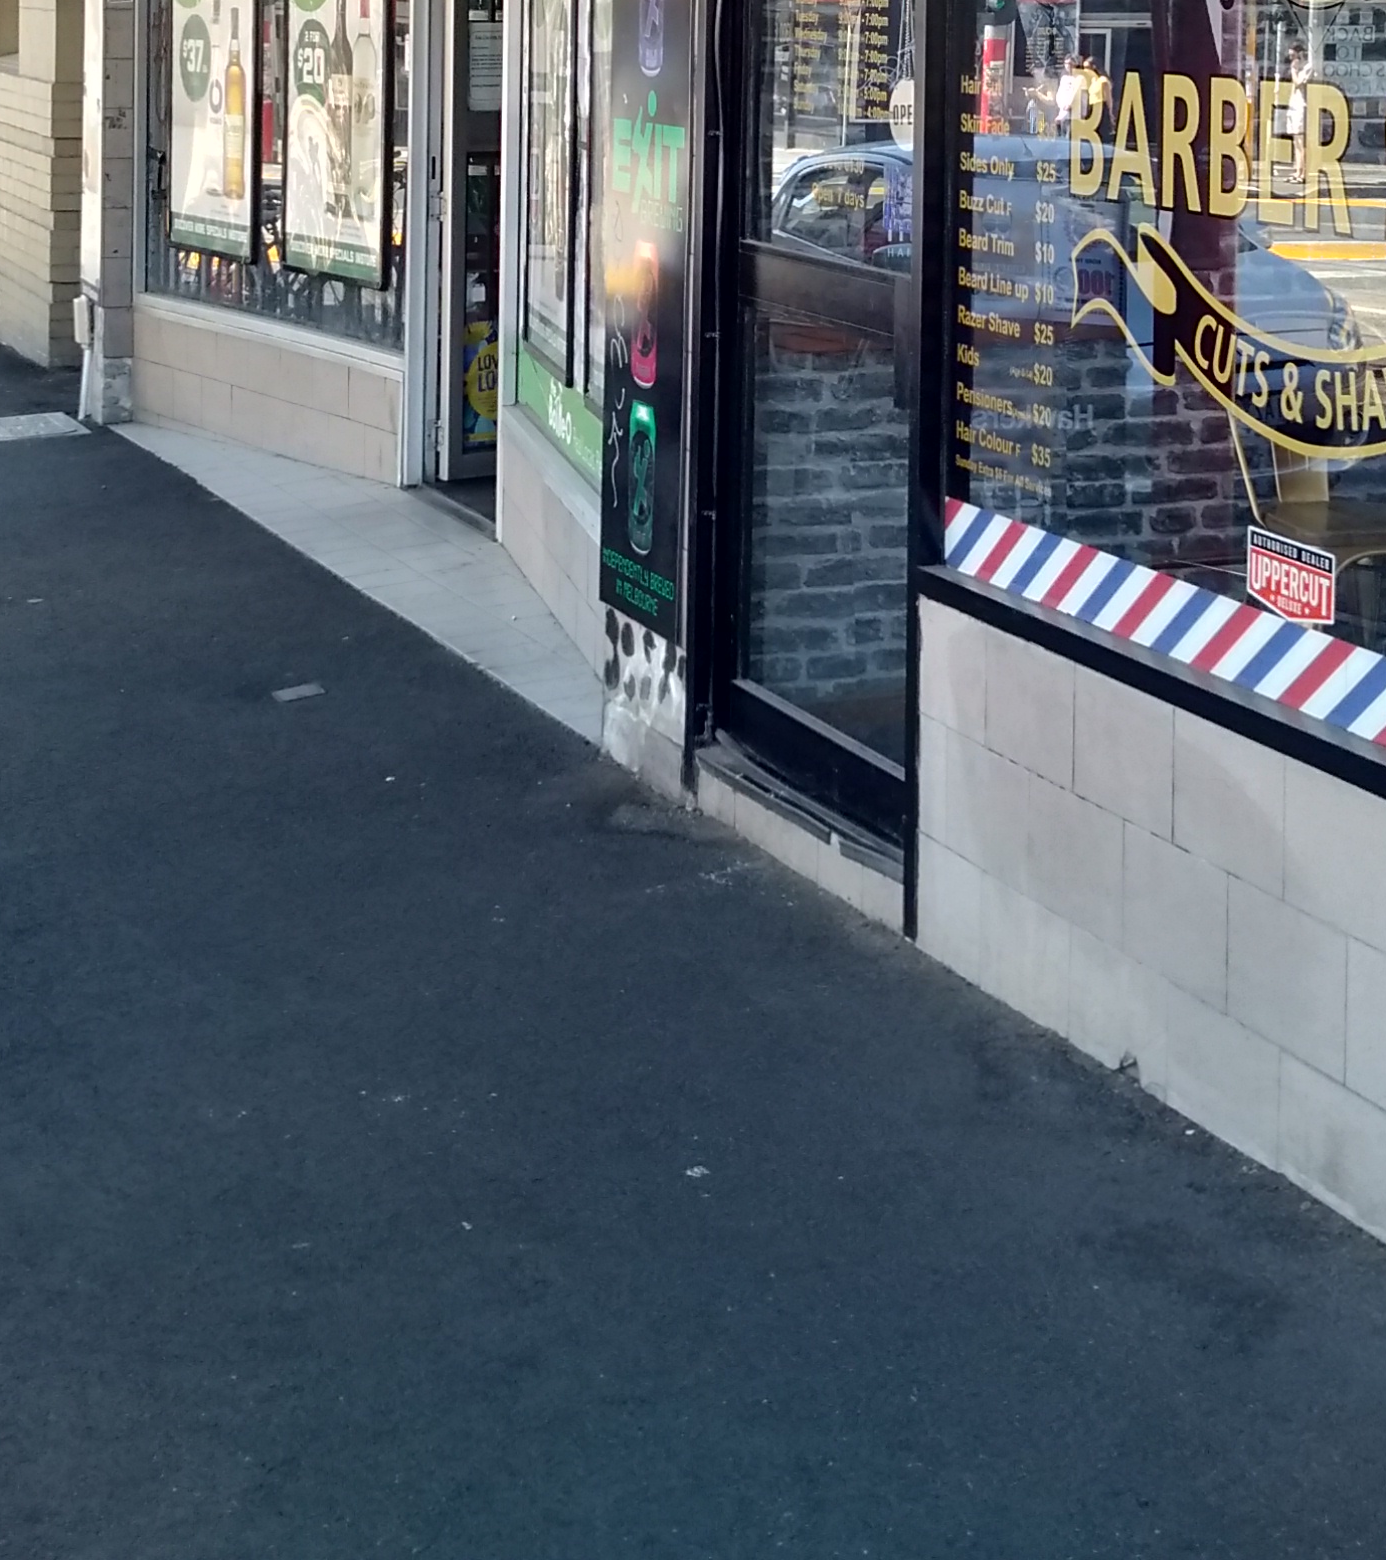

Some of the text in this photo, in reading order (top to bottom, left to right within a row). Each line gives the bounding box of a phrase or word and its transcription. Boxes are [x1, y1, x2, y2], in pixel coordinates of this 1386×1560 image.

[297, 47, 325, 84] $20
[986, 117, 1010, 136] Fade
[960, 151, 1056, 183] Sides Only $25
[1070, 68, 1353, 237] BARBER
[844, 192, 865, 210] days
[959, 190, 984, 210] Buzz
[986, 195, 1004, 214] Cut
[1035, 201, 1055, 223] $20
[959, 228, 1055, 263] Beard Trim $10
[958, 267, 1054, 305] Beard Line up $10
[957, 305, 1054, 345] Razer Shave $25
[957, 343, 1053, 386] Kids $20
[1194, 314, 1270, 409] CUTS
[1280, 362, 1303, 424] &
[956, 381, 1013, 415] Pensioners
[1033, 403, 1051, 428] $20
[956, 420, 977, 444] Hair
[979, 428, 1014, 455] Colour
[1031, 443, 1051, 468] $35
[1300, 550, 1330, 571] DEALER
[1251, 551, 1331, 617] UPPERCUT
